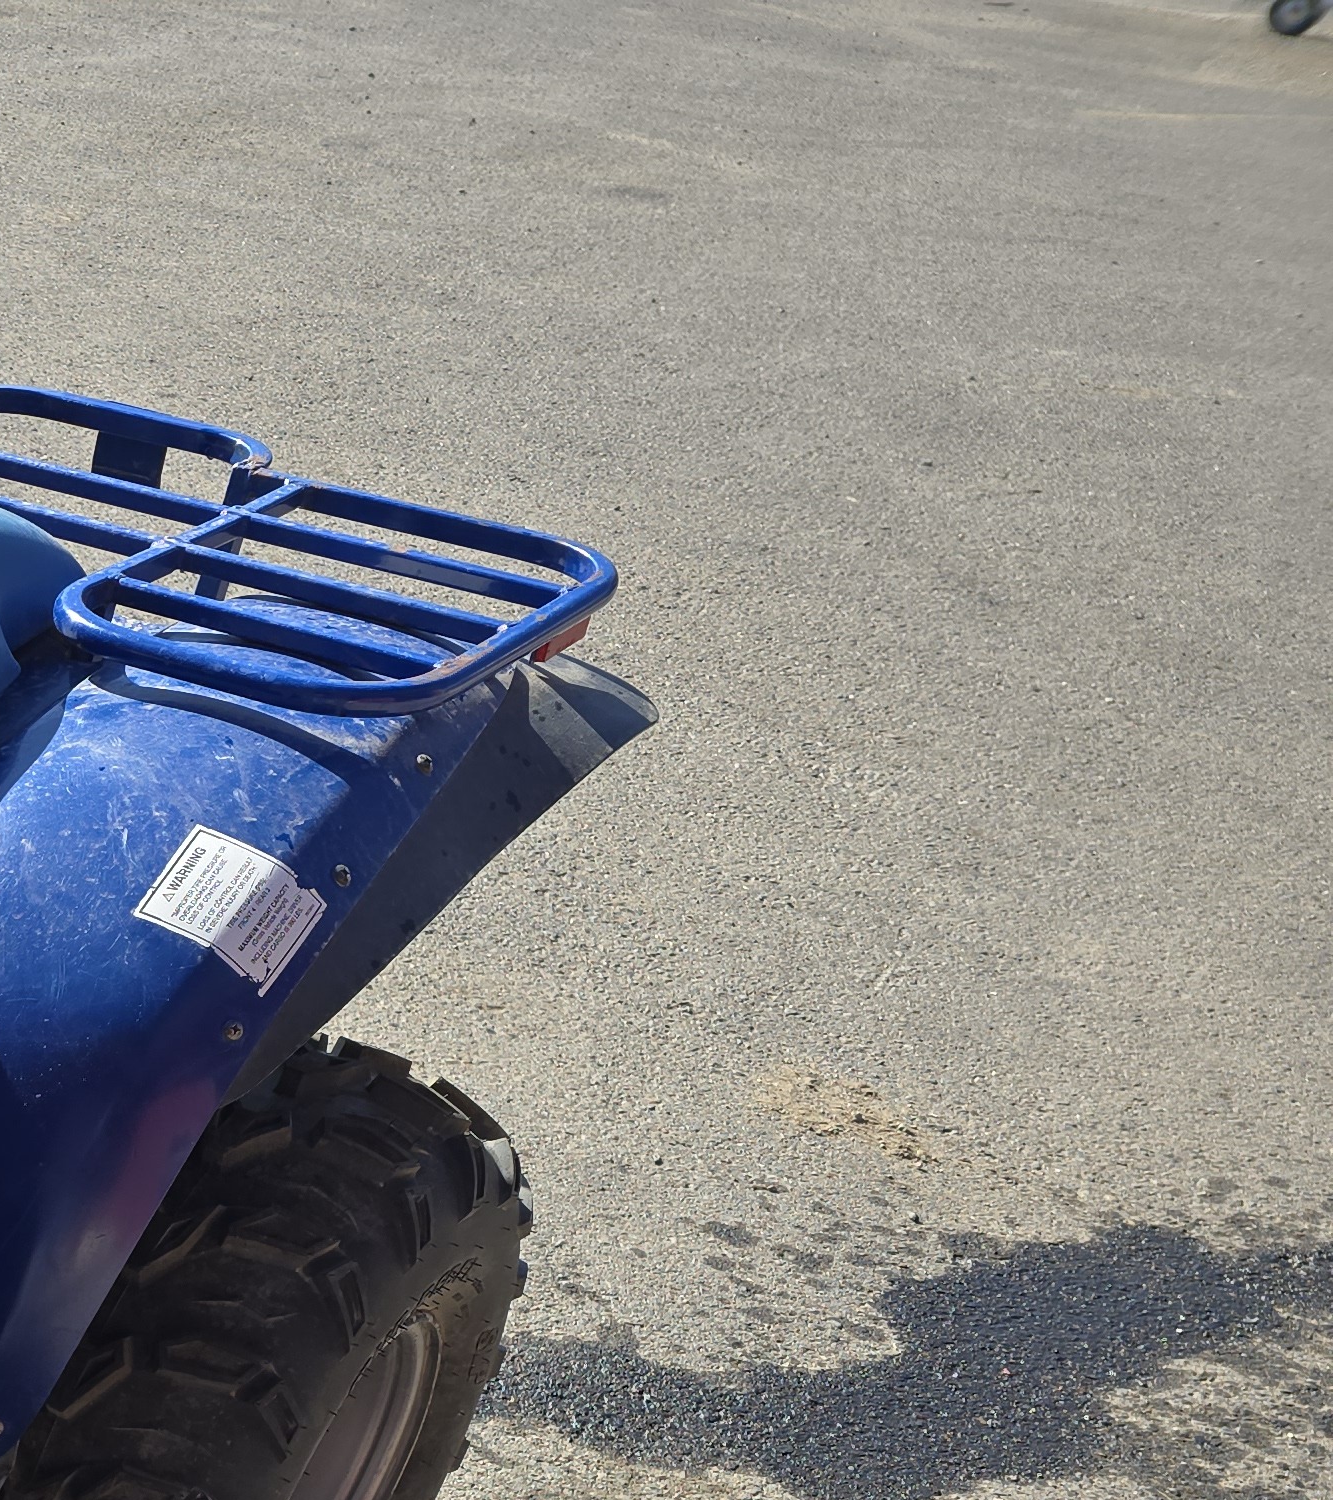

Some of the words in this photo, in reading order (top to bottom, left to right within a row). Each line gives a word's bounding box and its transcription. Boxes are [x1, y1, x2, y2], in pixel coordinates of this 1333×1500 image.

[167, 846, 207, 892] WARNING
[185, 909, 199, 925] LOSS
[196, 901, 204, 910] OF
[208, 905, 228, 928] SEVERE
[224, 888, 241, 907] INJURY
[237, 880, 246, 890] OR
[234, 889, 258, 916] PRESSURE
[196, 913, 211, 930] LOSS
[207, 906, 216, 916] OF
[237, 926, 259, 951] MAXIMUM
[255, 906, 274, 927] WEIGHT
[268, 883, 290, 907] CAPACITY
[237, 911, 253, 929] FRONT
[268, 931, 286, 951] CARGO
